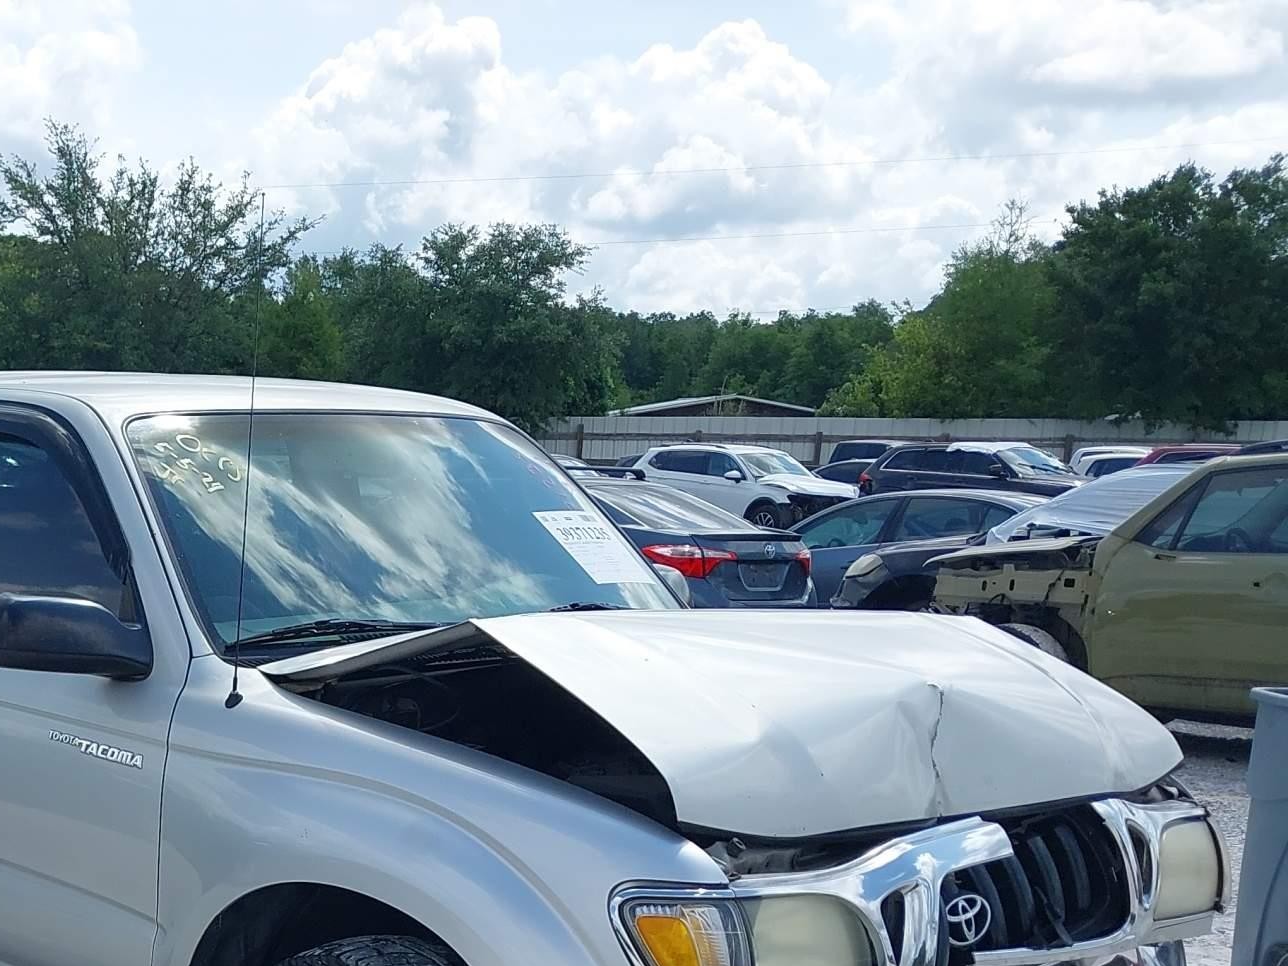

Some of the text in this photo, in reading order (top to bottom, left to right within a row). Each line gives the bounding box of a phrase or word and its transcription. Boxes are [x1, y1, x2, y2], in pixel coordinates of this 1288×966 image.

[555, 526, 612, 541] 39371235
[49, 730, 144, 769] TOYOTA TACOMA
